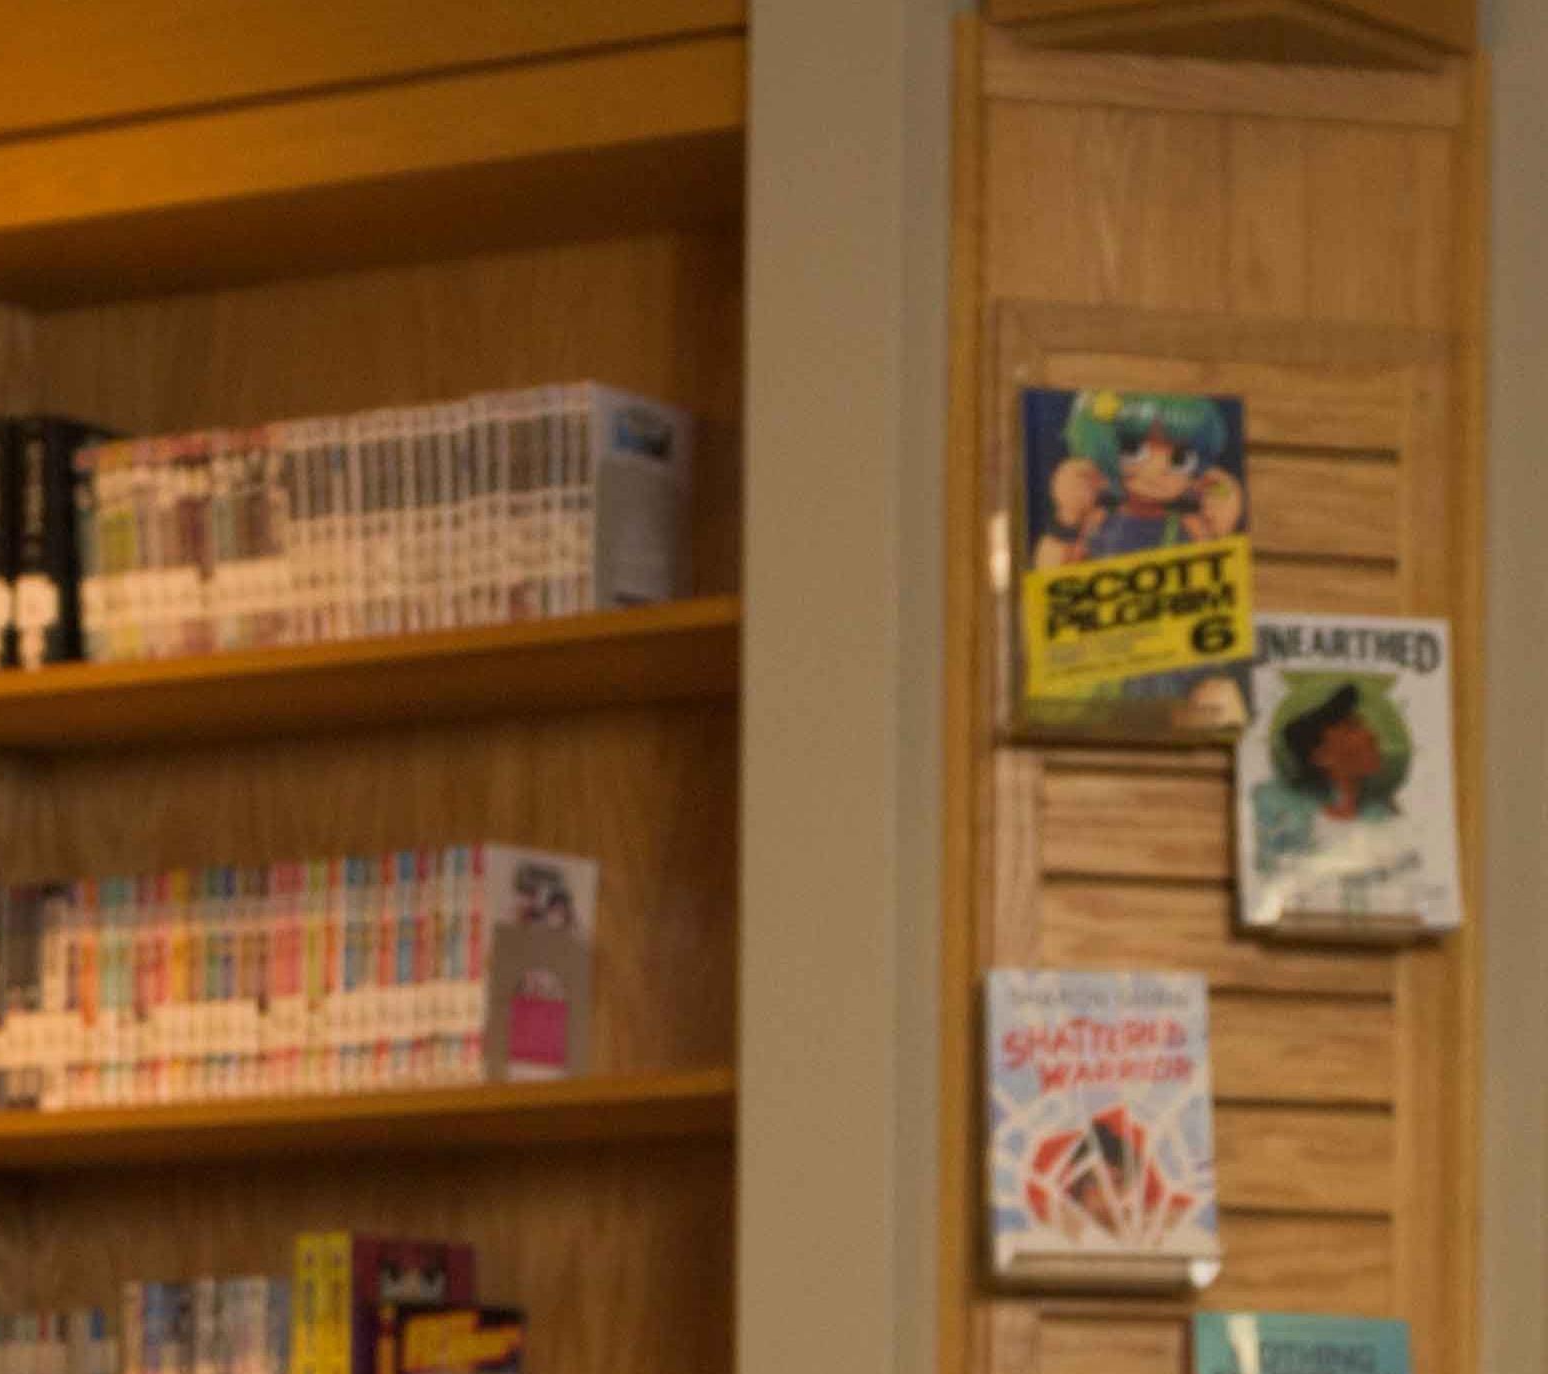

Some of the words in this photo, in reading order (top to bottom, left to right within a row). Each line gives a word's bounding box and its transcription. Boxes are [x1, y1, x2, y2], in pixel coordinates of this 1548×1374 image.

[1046, 549, 1236, 607] SCOTT
[1046, 583, 1236, 640] PILGRIM
[1190, 615, 1236, 653] 6
[1004, 1014, 1188, 1071] SHATTERED
[1037, 1054, 1194, 1098] WARRIOR
